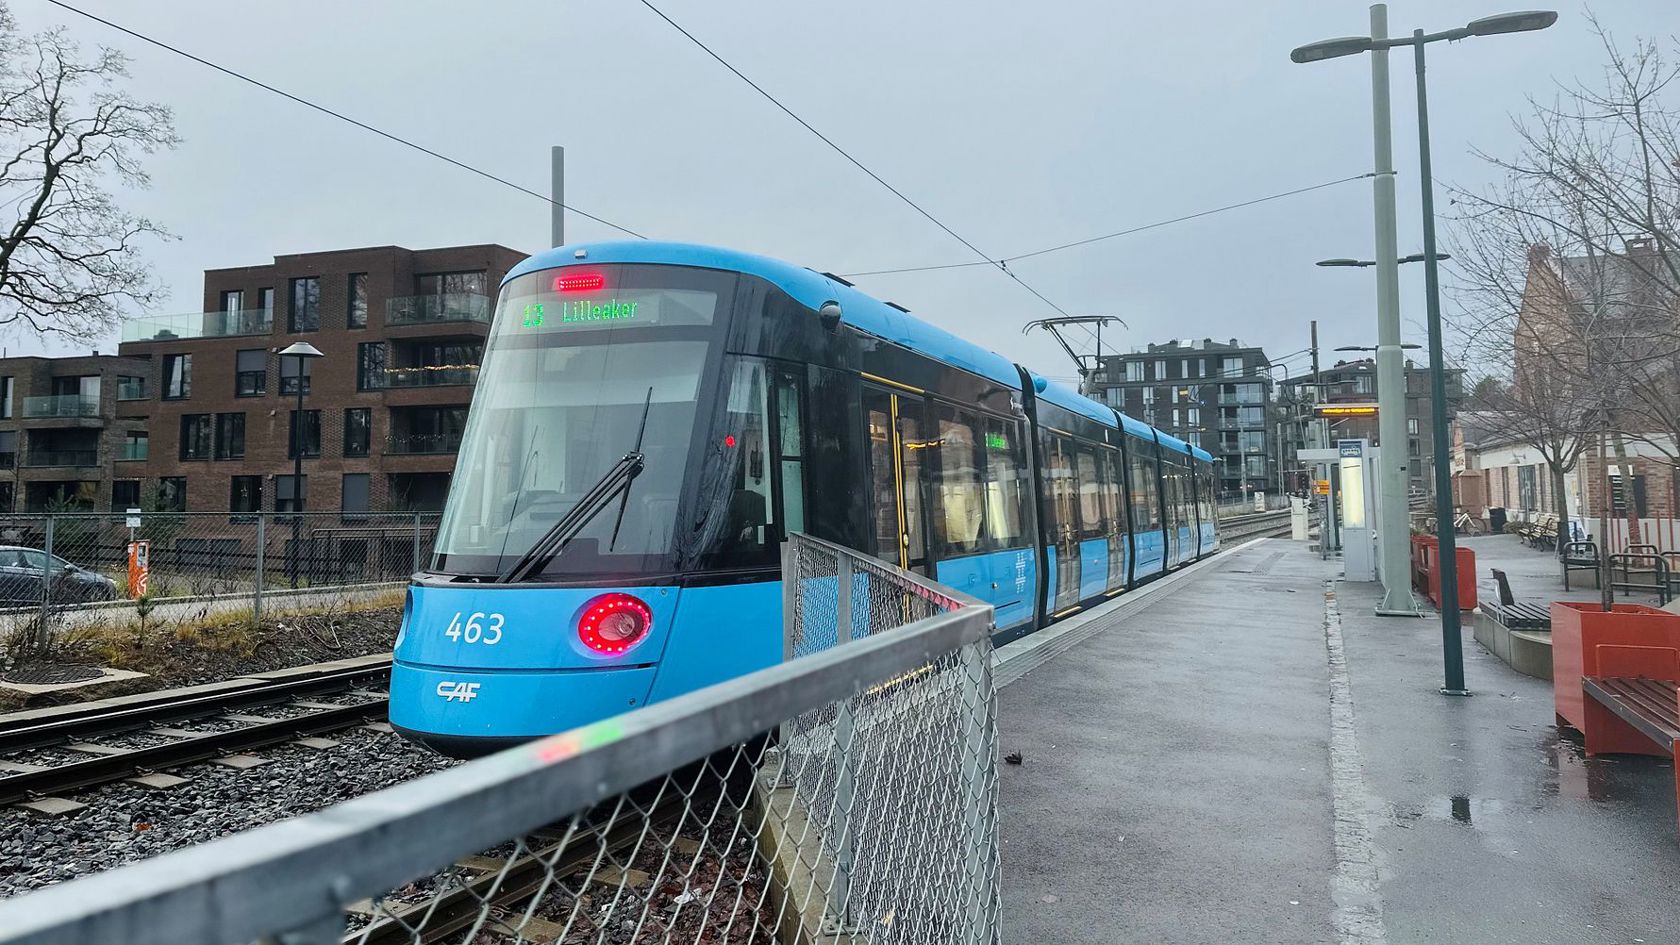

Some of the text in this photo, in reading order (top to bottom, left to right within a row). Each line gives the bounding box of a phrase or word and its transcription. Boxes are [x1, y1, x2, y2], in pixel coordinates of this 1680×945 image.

[522, 299, 638, 328] 13 Lilleaker
[445, 612, 505, 645] 463
[436, 681, 480, 703] CAF
